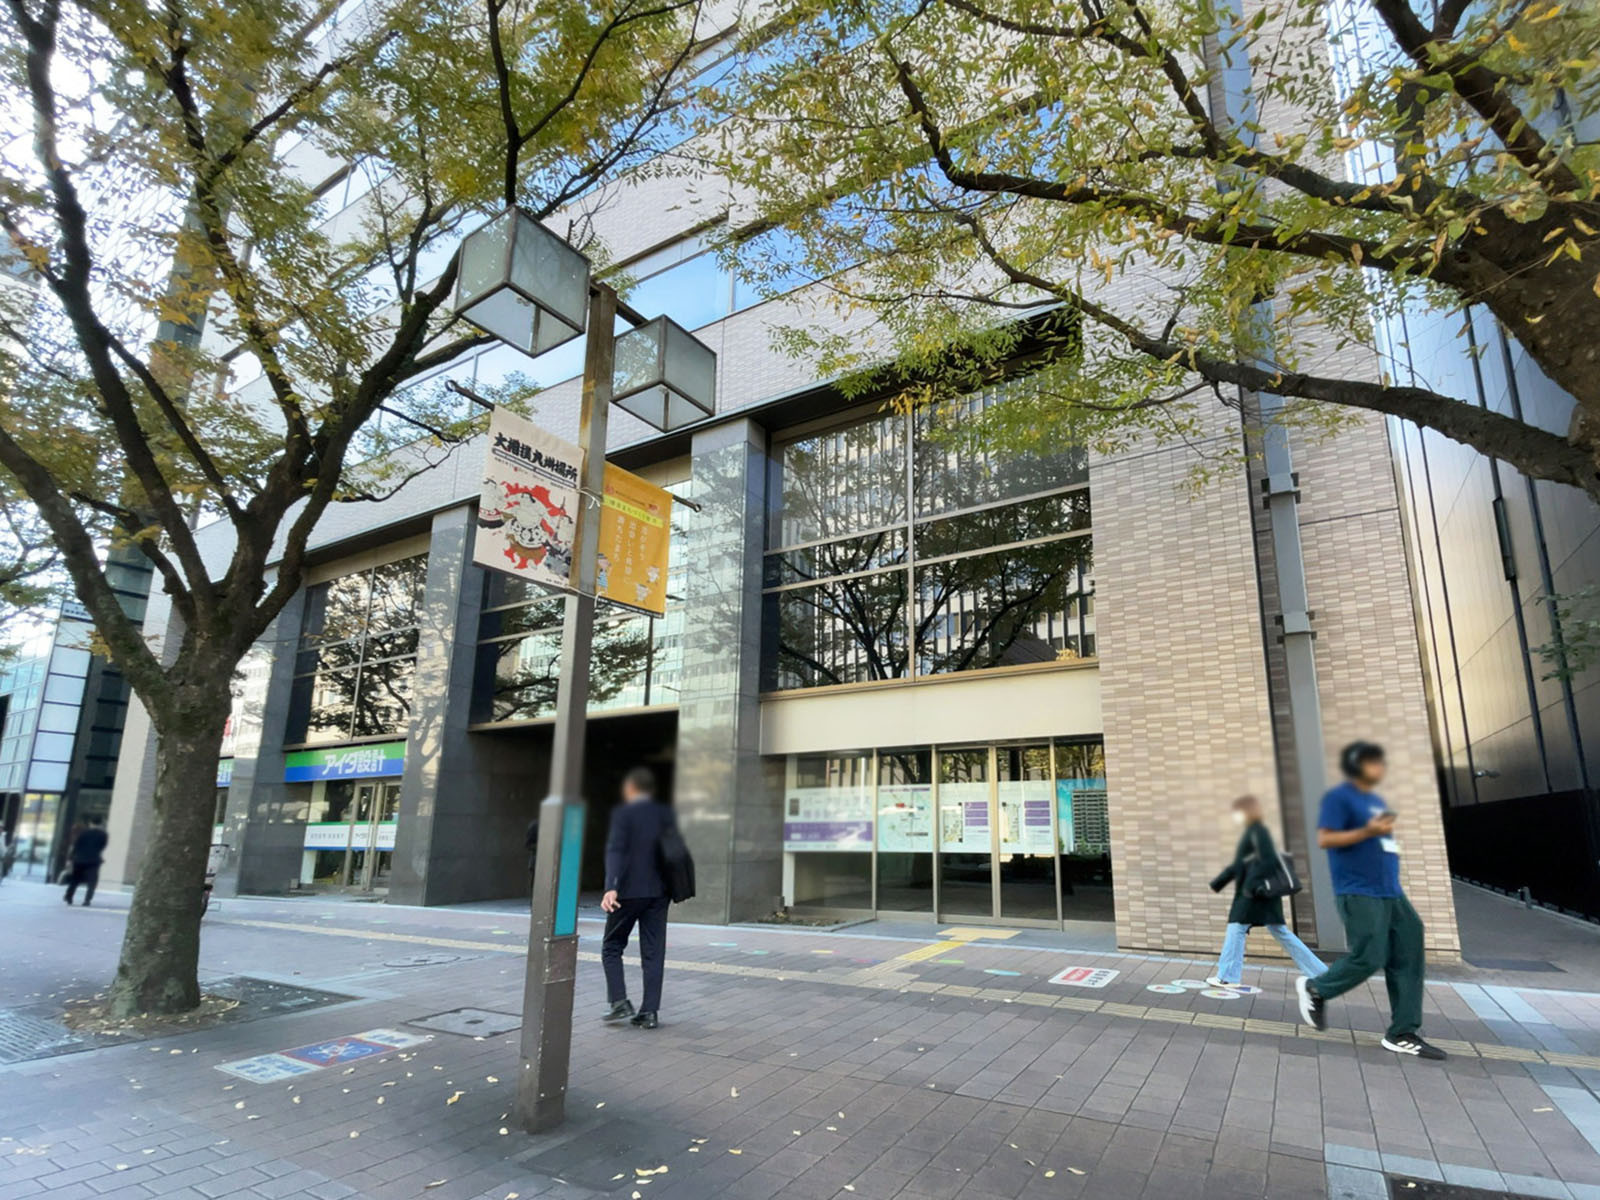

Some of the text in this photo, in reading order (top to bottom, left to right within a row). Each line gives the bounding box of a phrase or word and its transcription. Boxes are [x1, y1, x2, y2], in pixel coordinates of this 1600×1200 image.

[494, 432, 578, 482] 大相撲九州場所
